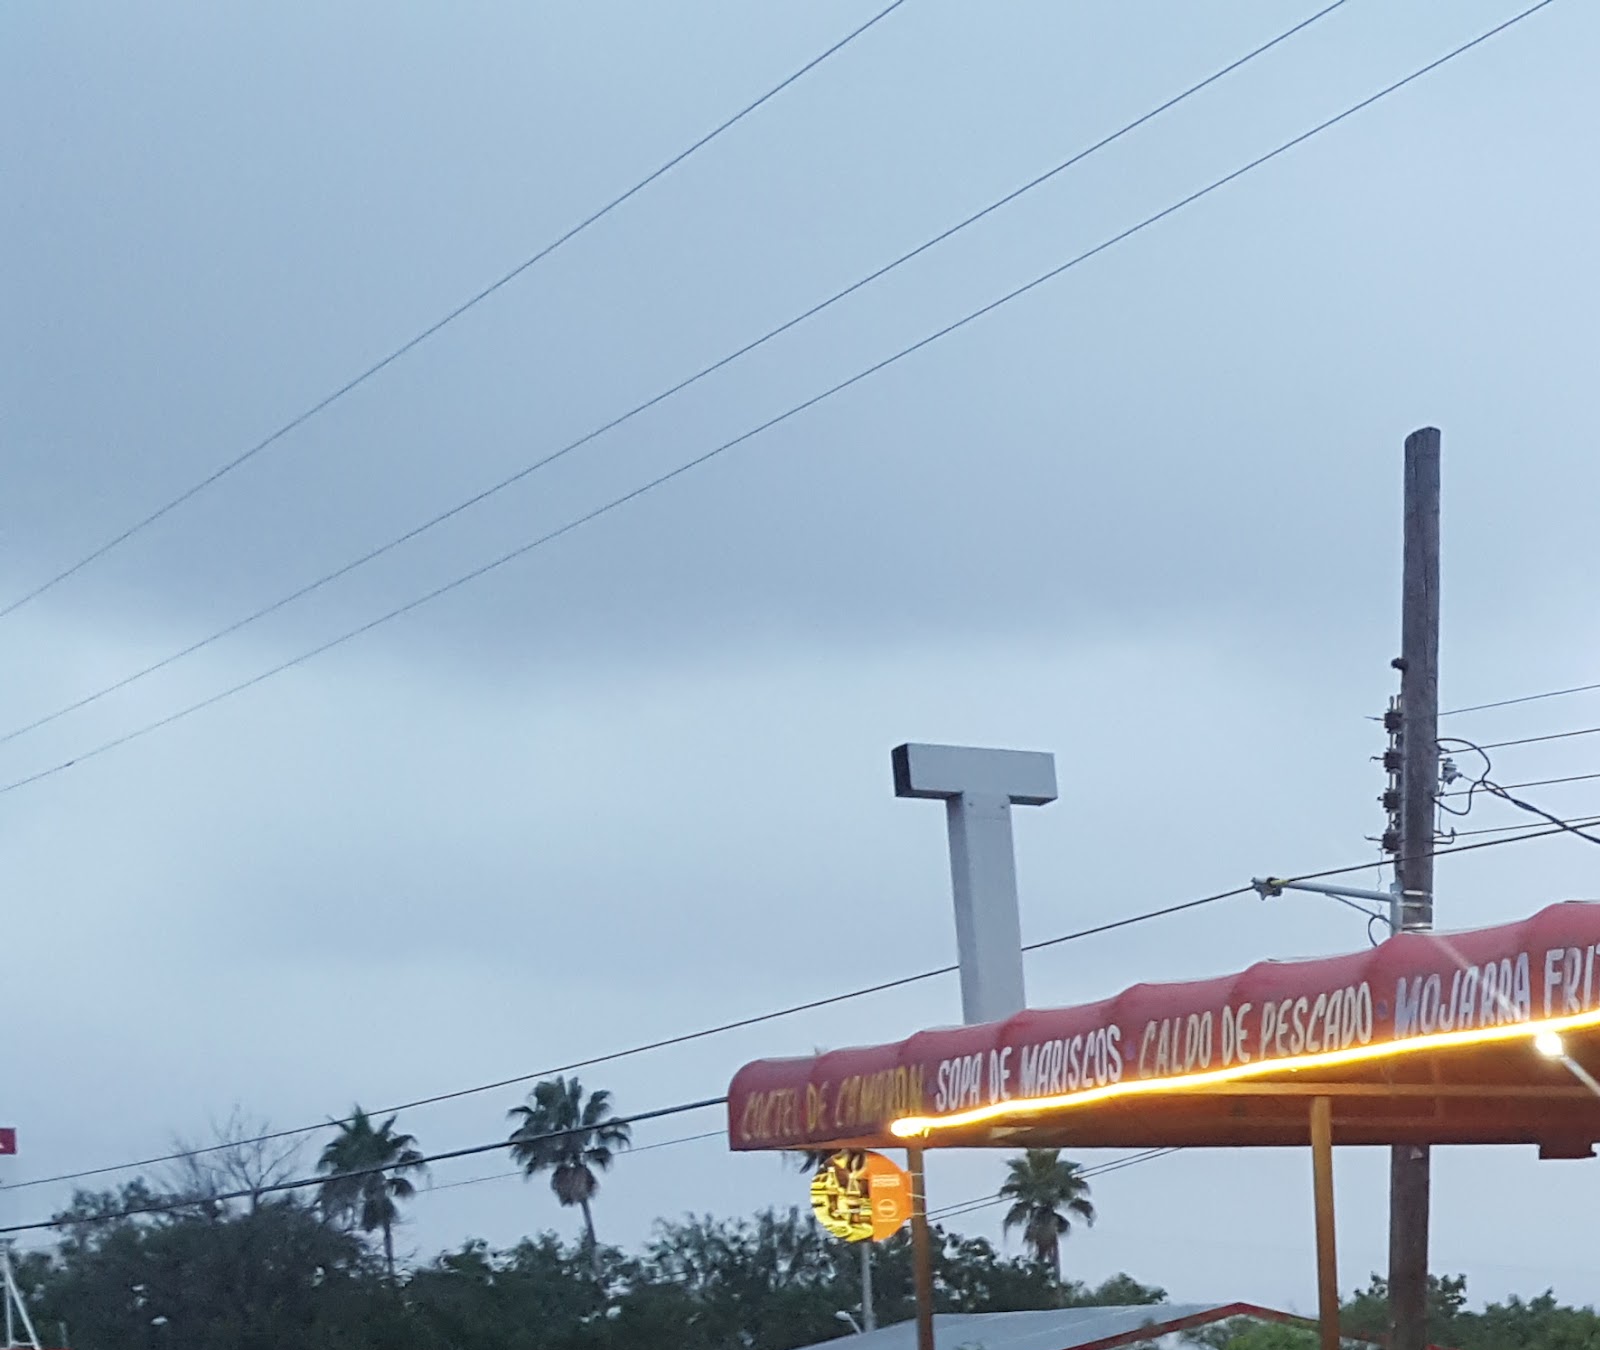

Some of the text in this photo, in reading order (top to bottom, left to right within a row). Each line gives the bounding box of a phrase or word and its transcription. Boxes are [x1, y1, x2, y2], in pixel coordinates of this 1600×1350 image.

[806, 1081, 828, 1131] DE
[935, 1054, 983, 1112] SOPA
[988, 1046, 1012, 1101] DE
[1019, 1024, 1124, 1098] MARISCOS
[1139, 1011, 1212, 1079] CALDO
[1221, 1002, 1252, 1066] DE
[1259, 981, 1372, 1061] PESCADO
[1394, 952, 1531, 1039] MOJARRA
